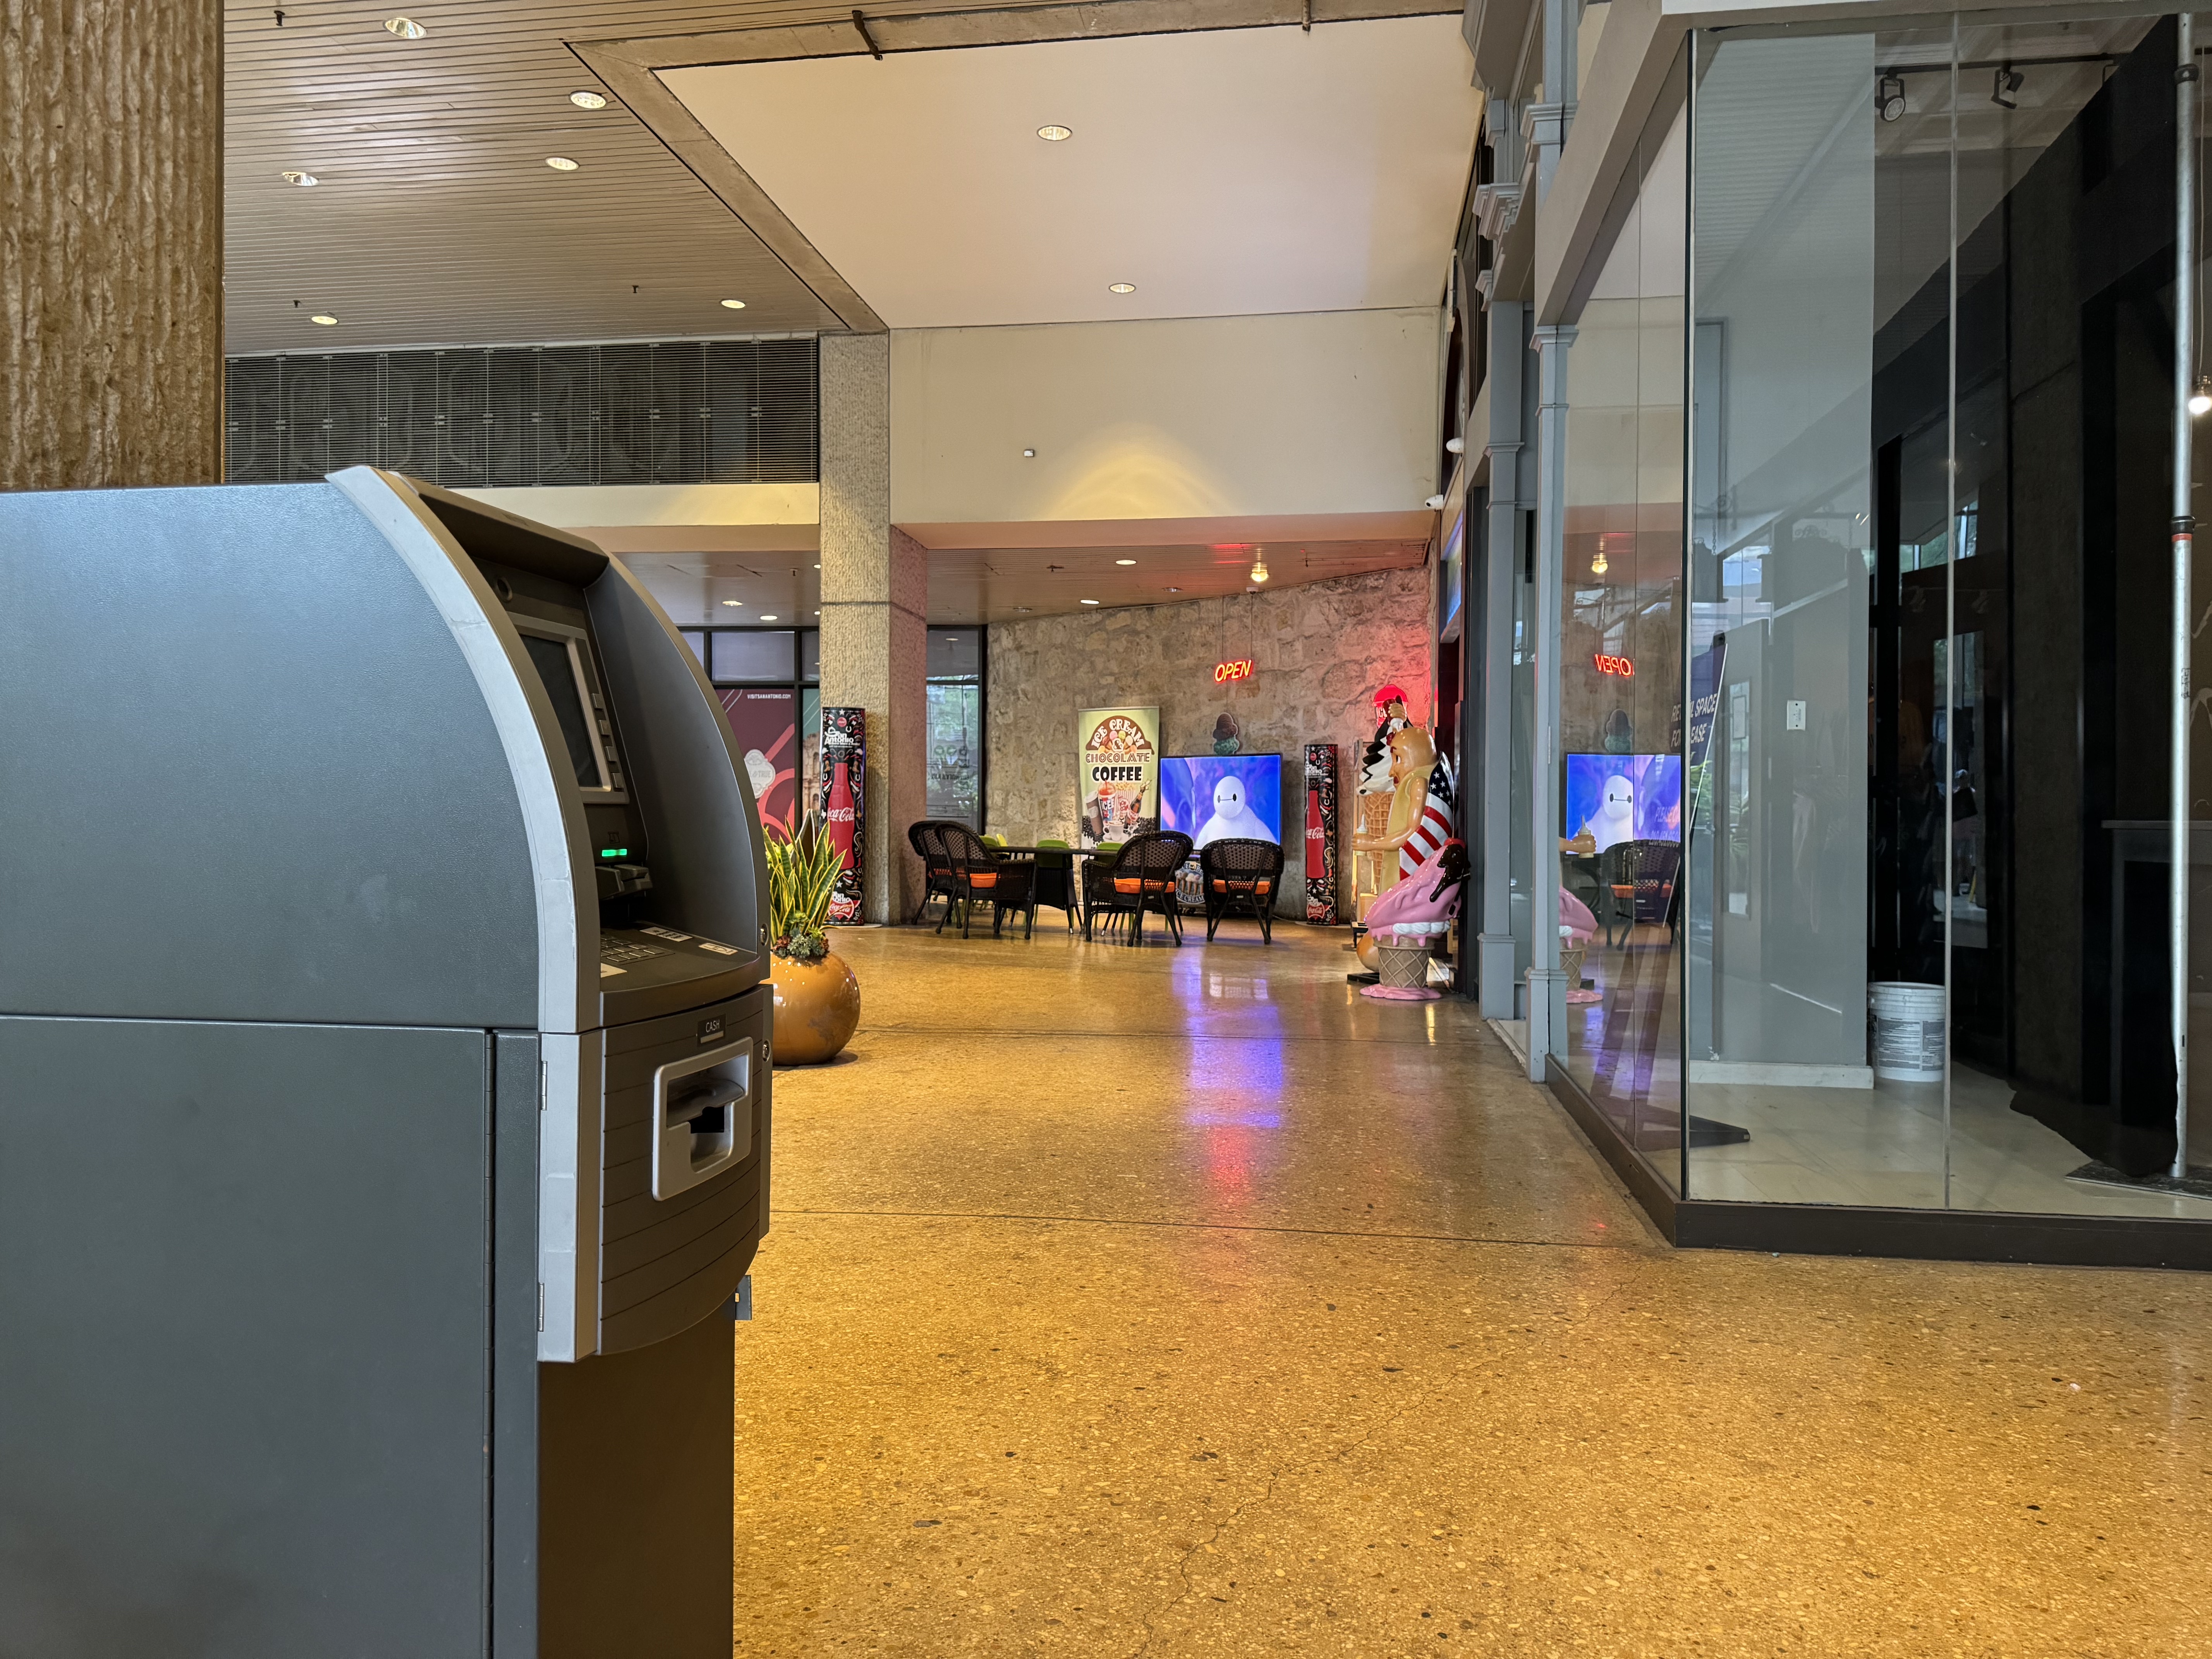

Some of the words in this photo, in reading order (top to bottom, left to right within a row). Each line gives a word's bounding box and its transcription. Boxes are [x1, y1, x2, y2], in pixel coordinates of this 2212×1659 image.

[1215, 659, 1252, 682] OPEN
[1695, 693, 1717, 717] SPACE
[1091, 725, 1108, 748] ICE
[1109, 718, 1145, 747] CREAM
[1690, 723, 1707, 744] EASE
[1113, 739, 1123, 750] &
[1085, 752, 1150, 763] CHOCOLATE
[1092, 766, 1142, 781] COFFEE
[706, 1019, 720, 1032] CASH
